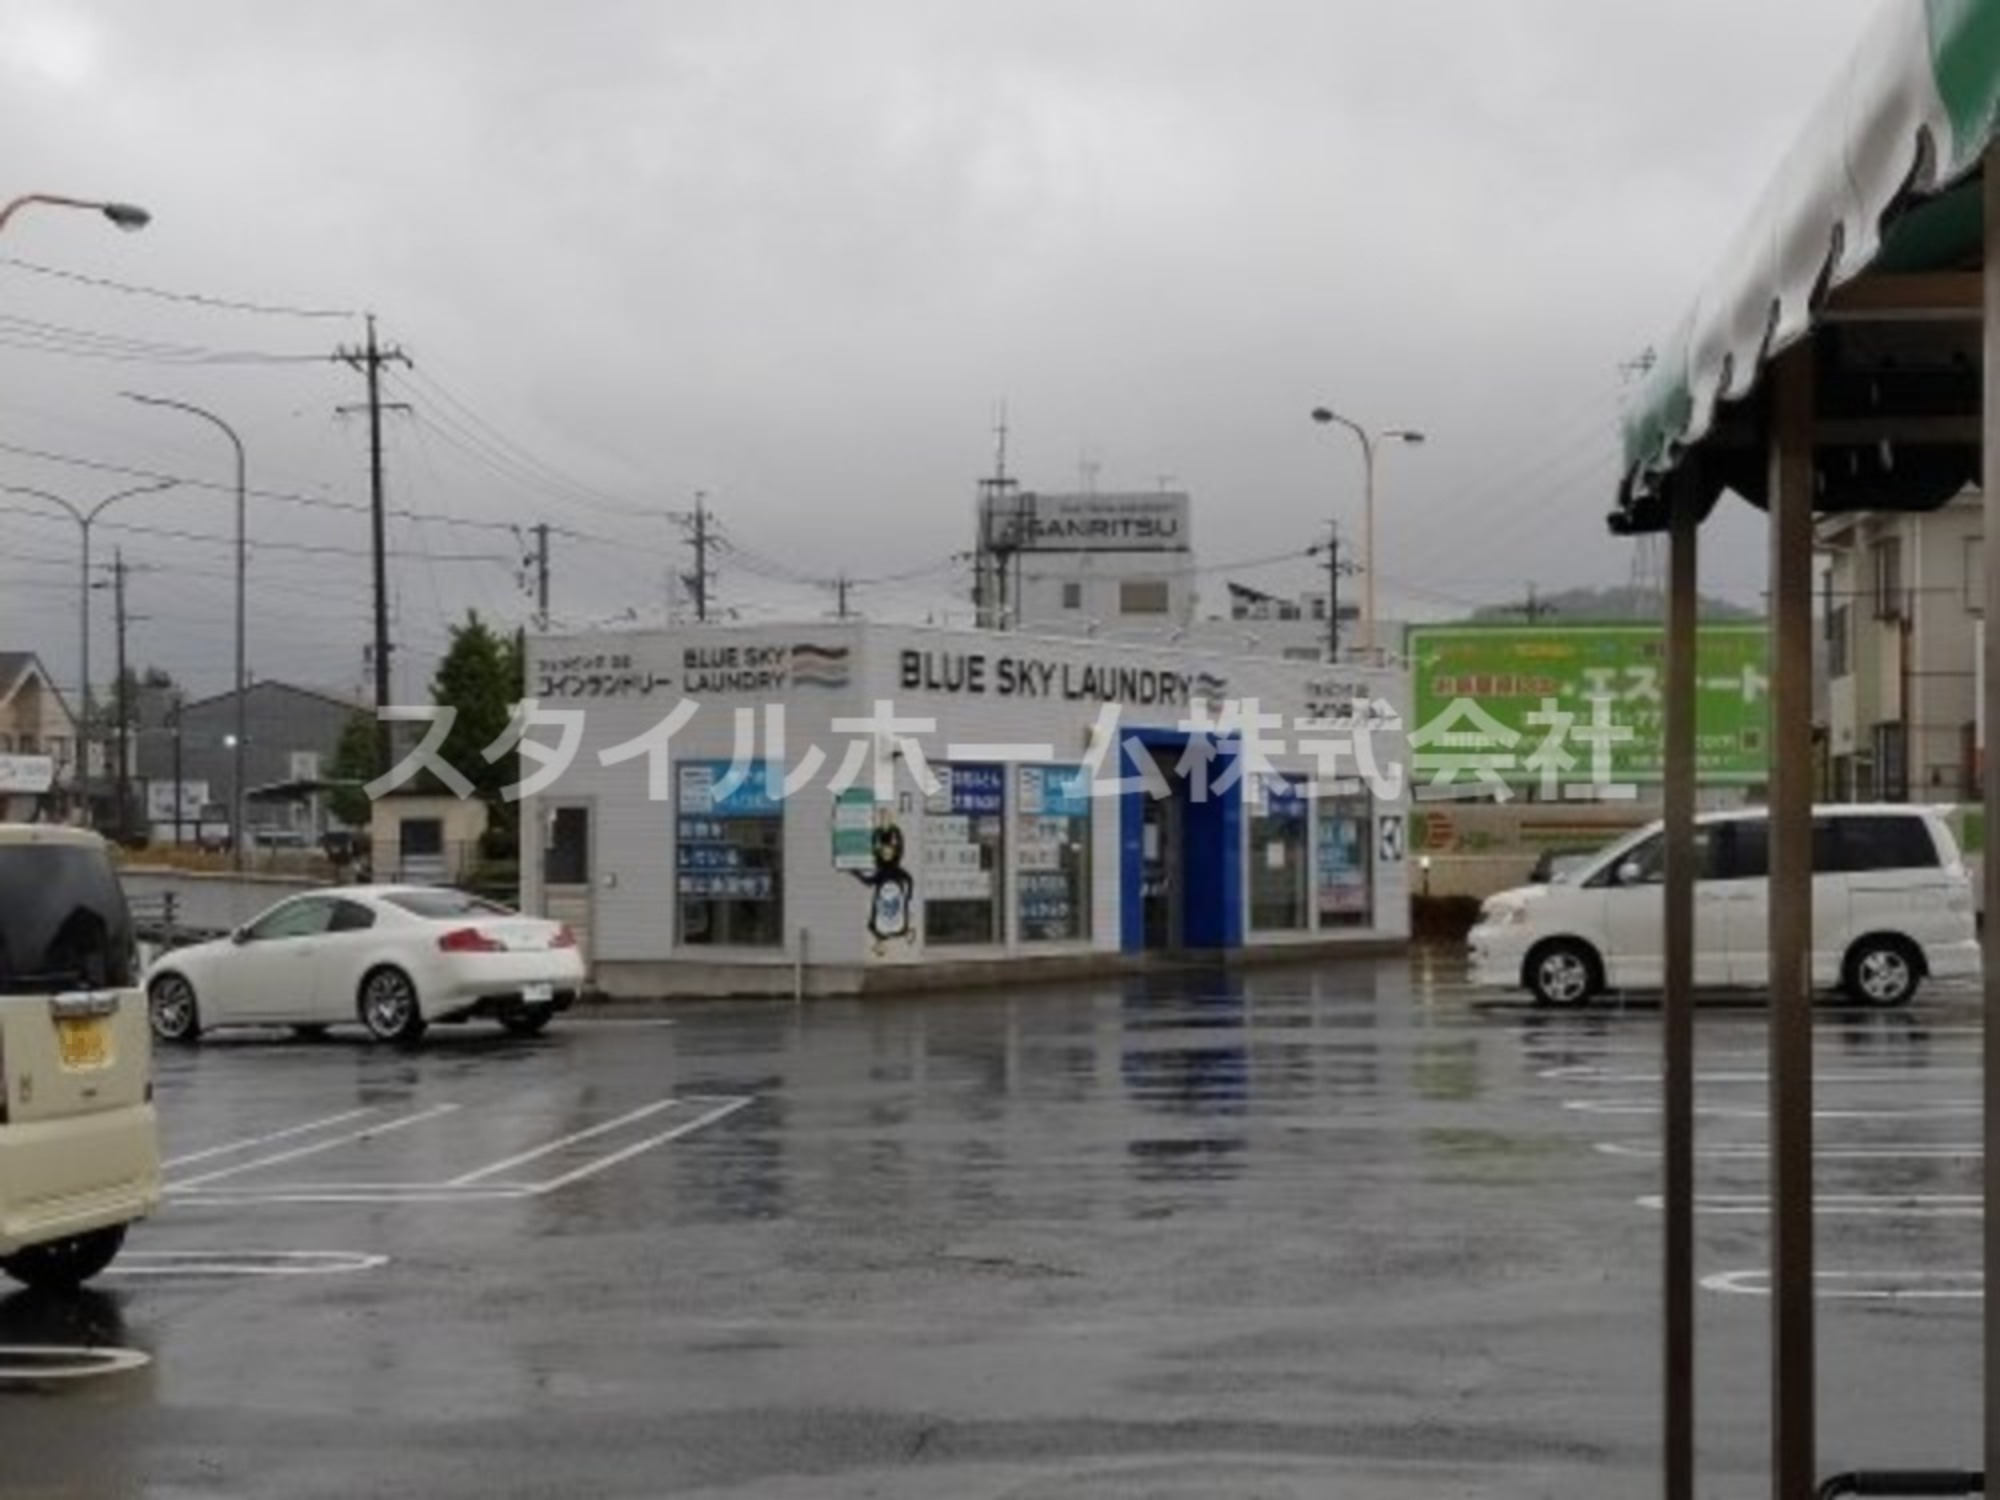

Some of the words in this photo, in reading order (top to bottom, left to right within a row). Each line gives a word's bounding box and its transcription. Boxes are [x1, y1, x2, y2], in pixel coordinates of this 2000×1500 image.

[683, 646, 738, 669] BLUE
[744, 646, 786, 669] SKY
[537, 671, 672, 697] コインランドリー
[683, 670, 786, 693] LAUNDRY
[899, 649, 986, 694] BLUE
[995, 657, 1058, 698] SKY
[1062, 662, 1194, 706] LAUNDRY
